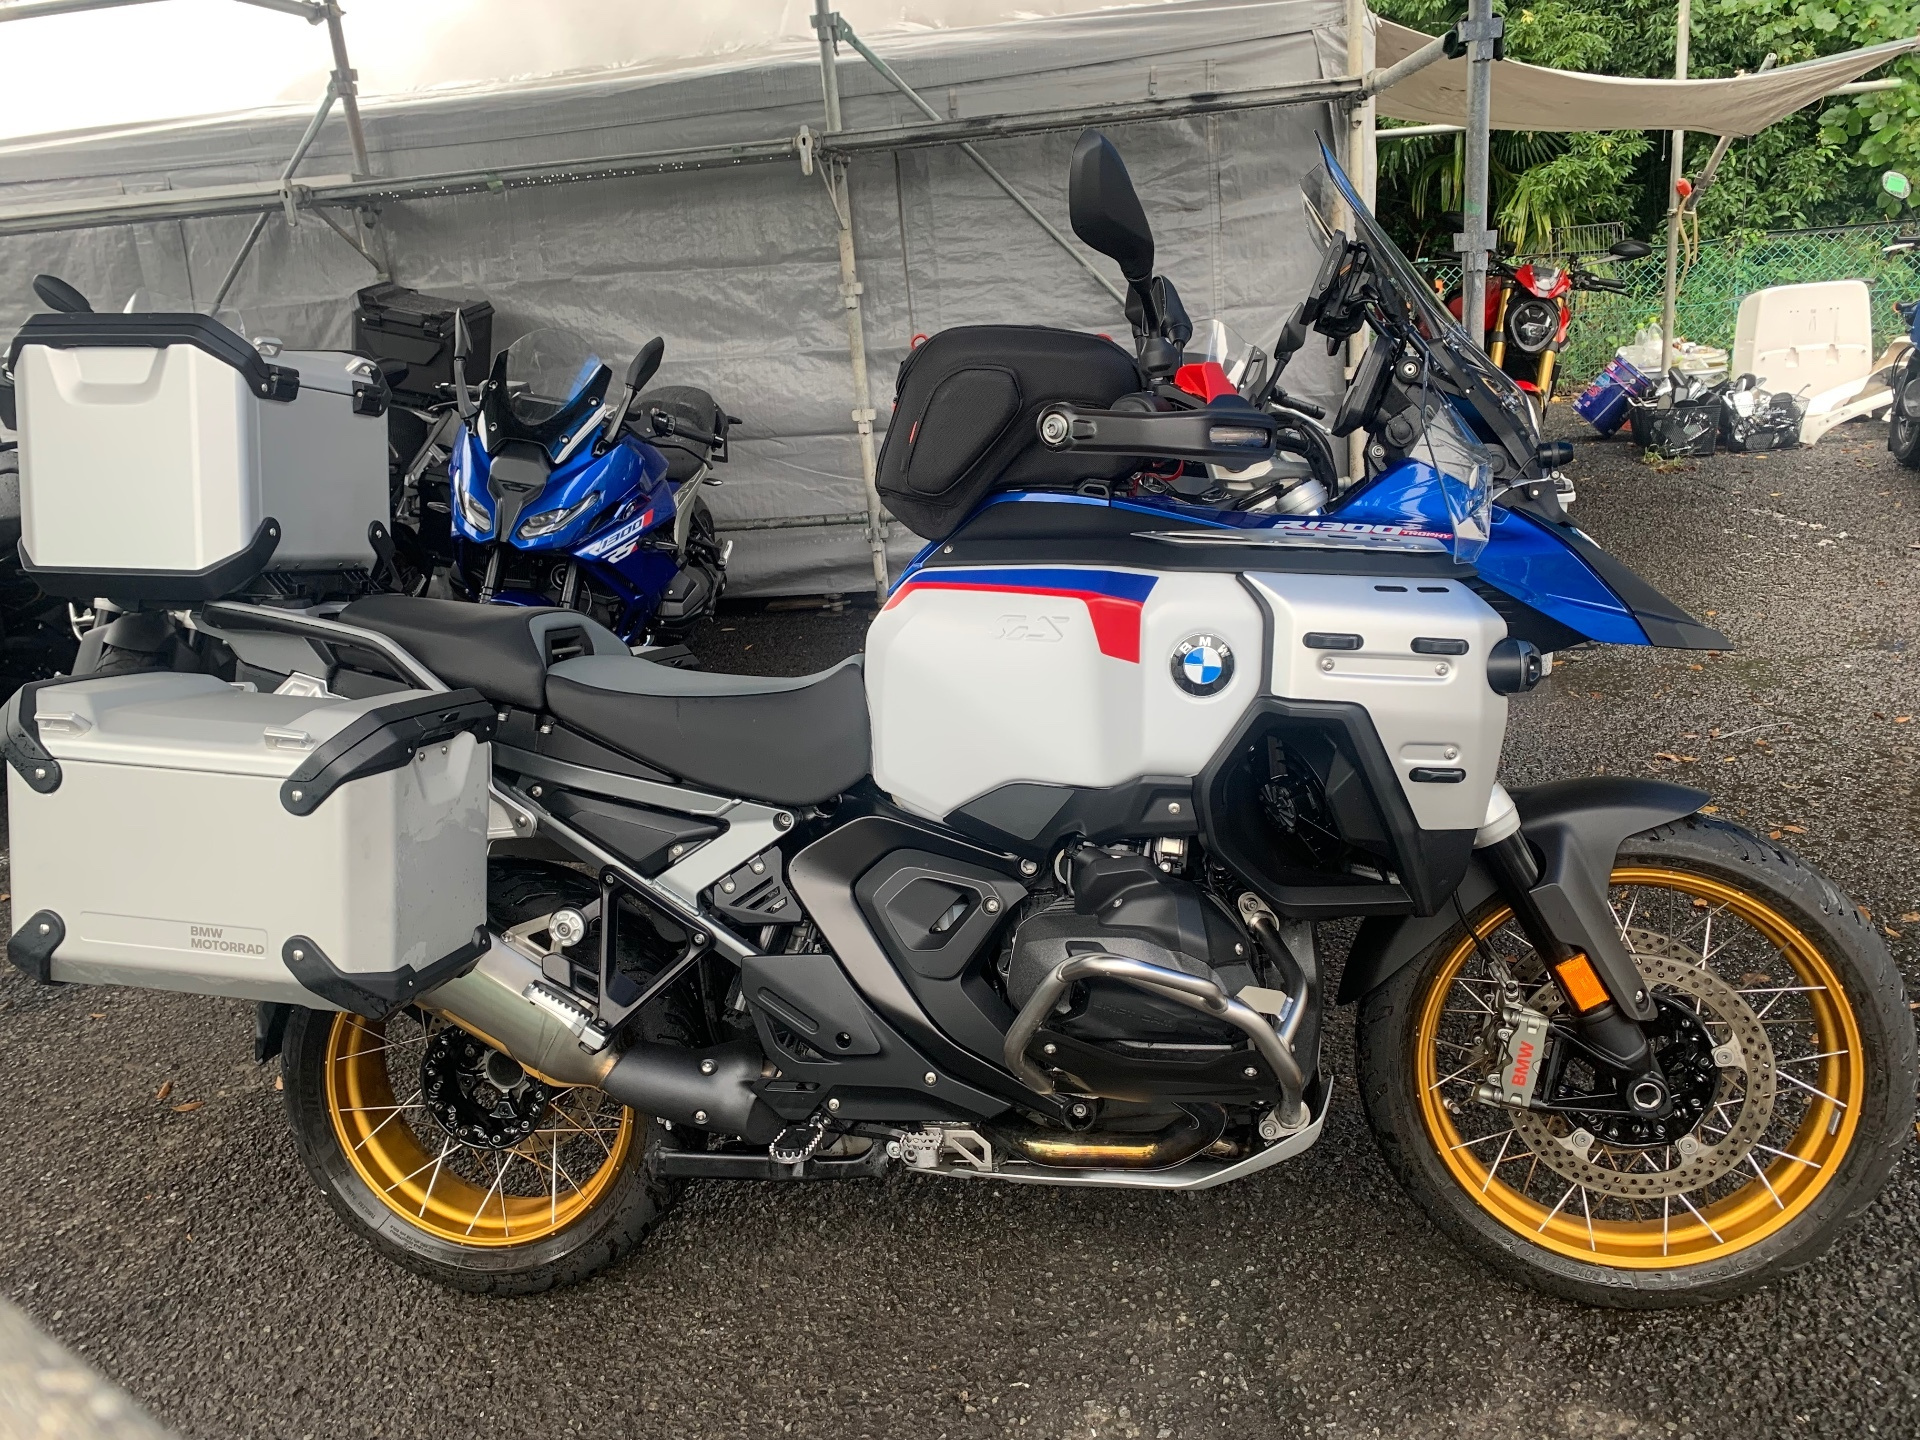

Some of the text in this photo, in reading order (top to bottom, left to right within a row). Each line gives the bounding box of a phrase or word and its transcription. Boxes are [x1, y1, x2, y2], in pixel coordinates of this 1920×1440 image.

[573, 513, 645, 557] R1300
[1272, 520, 1453, 539] R1300 TROPHY
[1179, 636, 1231, 659] BMW
[190, 926, 223, 938] BMW
[190, 938, 264, 954] MOTORRAD
[1511, 1040, 1534, 1087] BMW
